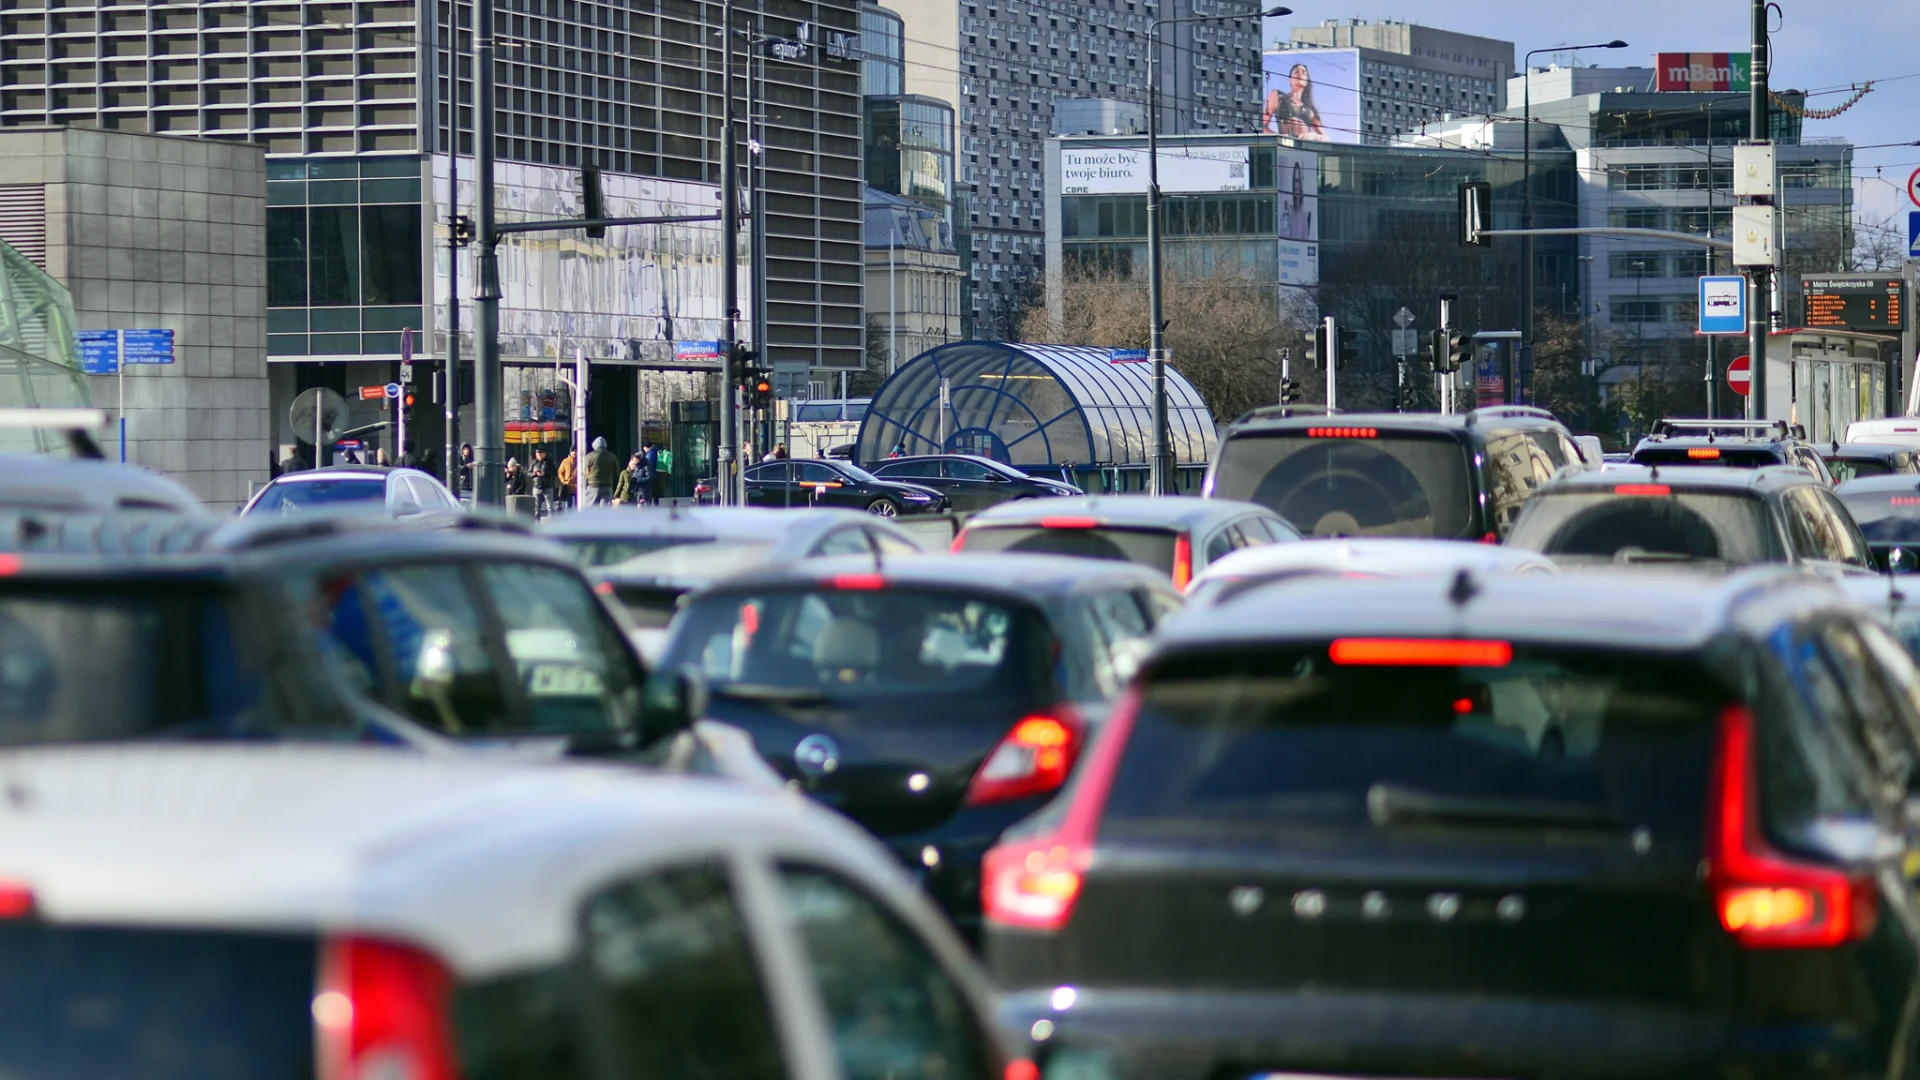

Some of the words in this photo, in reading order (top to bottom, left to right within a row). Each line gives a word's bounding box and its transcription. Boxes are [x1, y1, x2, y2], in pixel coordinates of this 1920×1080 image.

[1668, 63, 1746, 82] mBank
[1065, 154, 1082, 165] Tu
[1084, 153, 1116, 165] może
[1118, 152, 1139, 168] być
[1200, 151, 1216, 160] 544
[1233, 150, 1245, 159] 00
[1065, 168, 1097, 181] twoje
[1099, 167, 1133, 179] biuro.
[1065, 186, 1089, 194] CBRE
[1829, 280, 1866, 289] Świętokrzyska
[679, 344, 715, 354] Świętokrzyska
[1111, 351, 1146, 361] Świętokrzyska
